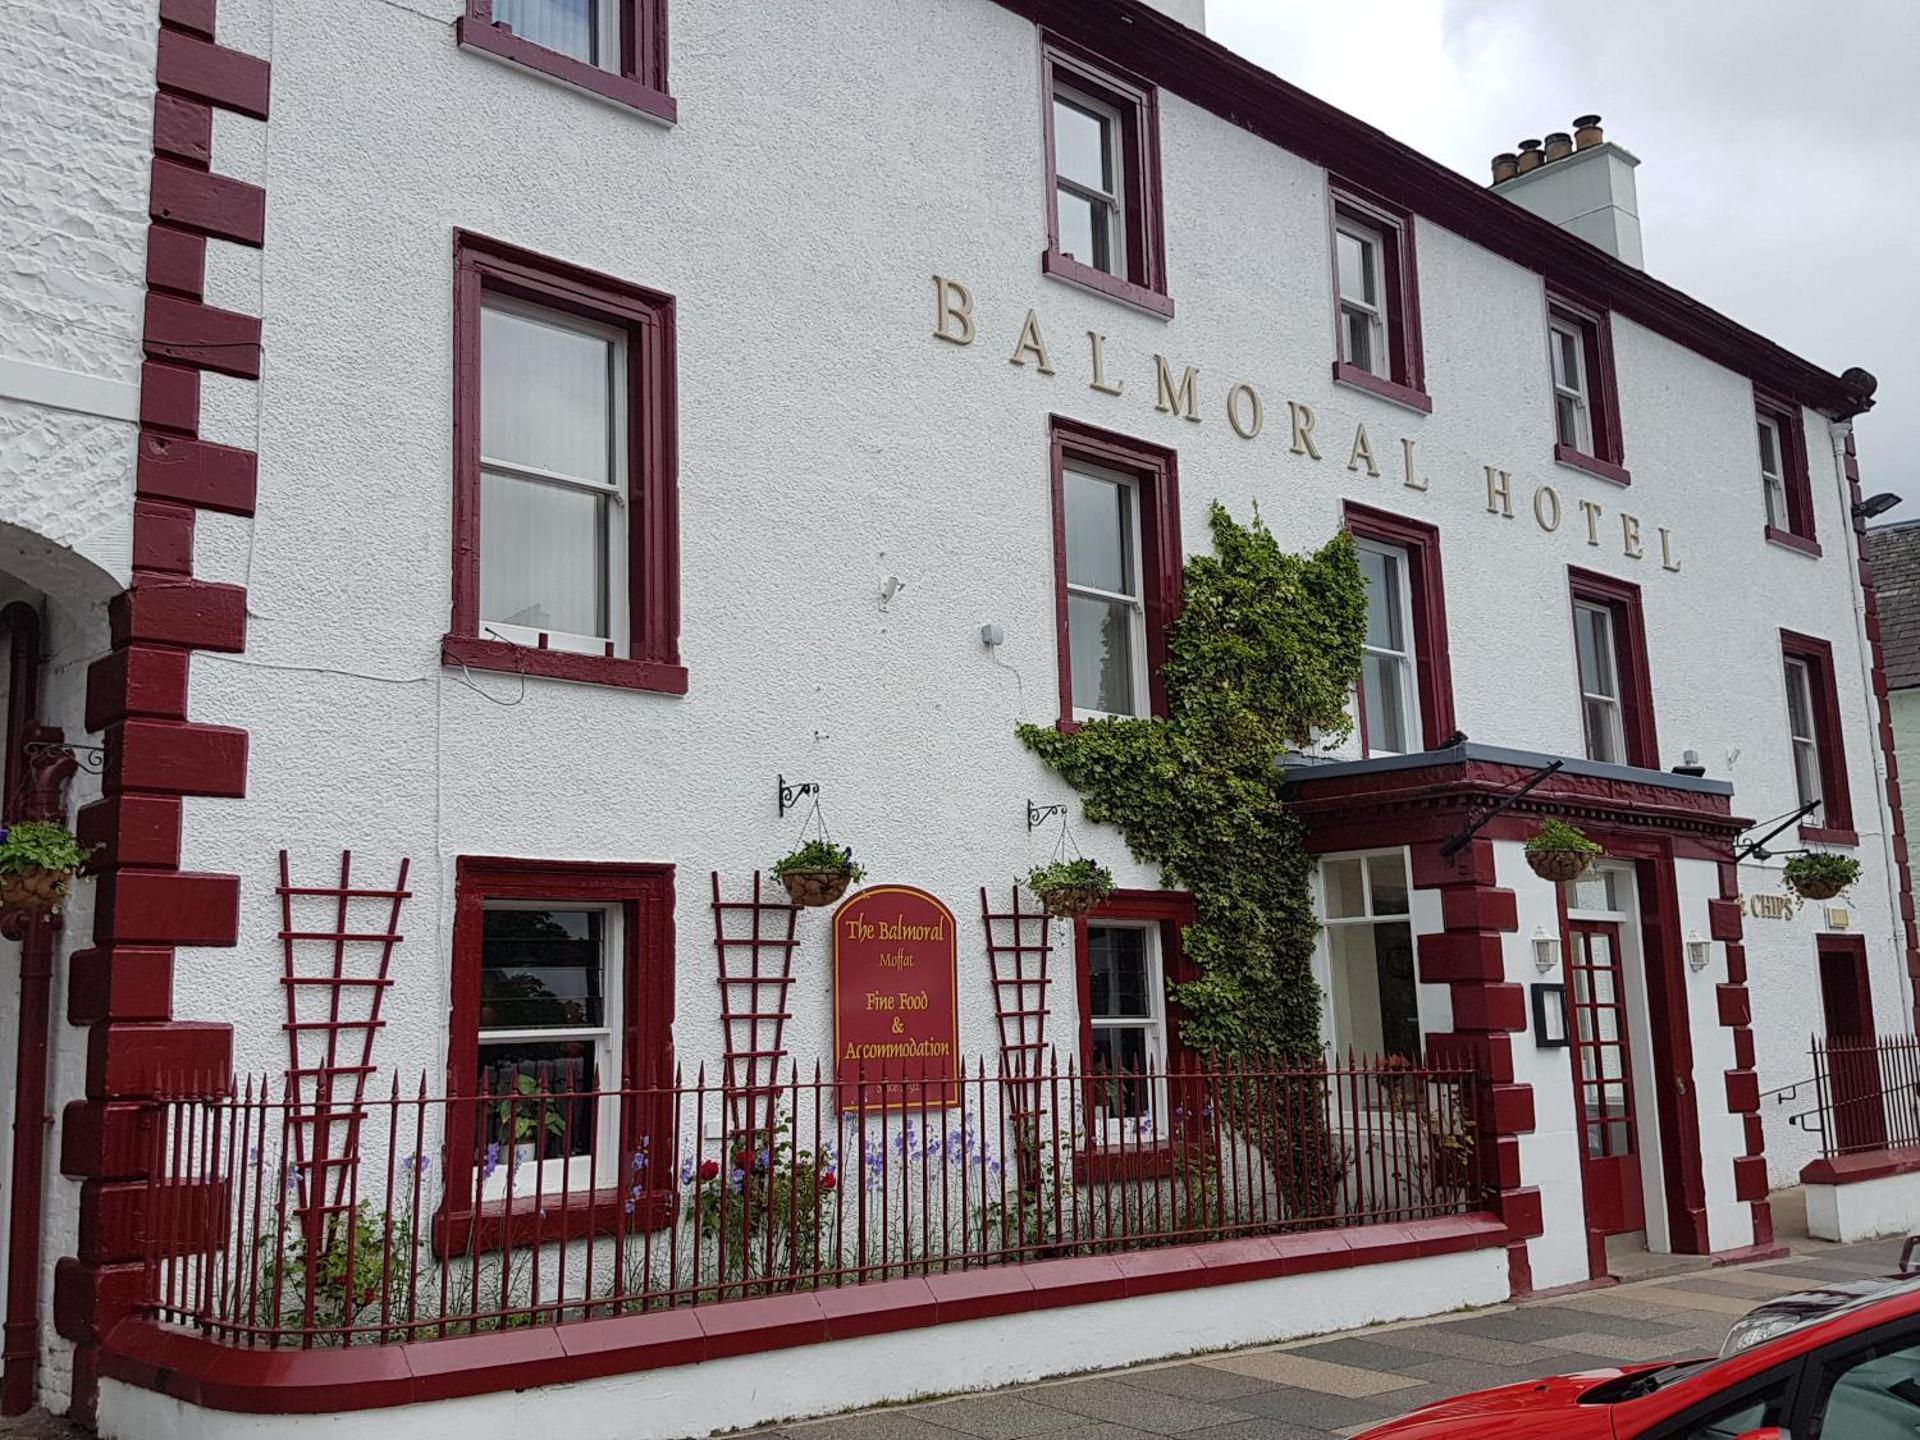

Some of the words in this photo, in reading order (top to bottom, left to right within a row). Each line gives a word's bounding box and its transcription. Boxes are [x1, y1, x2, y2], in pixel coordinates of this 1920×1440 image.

[932, 274, 1429, 492] BALMORAL
[1484, 465, 1681, 573] HOTEL
[1750, 894, 1794, 921] CHIPS
[845, 912, 875, 943] The
[878, 913, 944, 941] Balmoral
[880, 947, 914, 972] Moffat
[865, 990, 895, 1010] Fine
[898, 990, 928, 1010] Food
[891, 1016, 905, 1034] &
[844, 1037, 950, 1059] Accommodation
